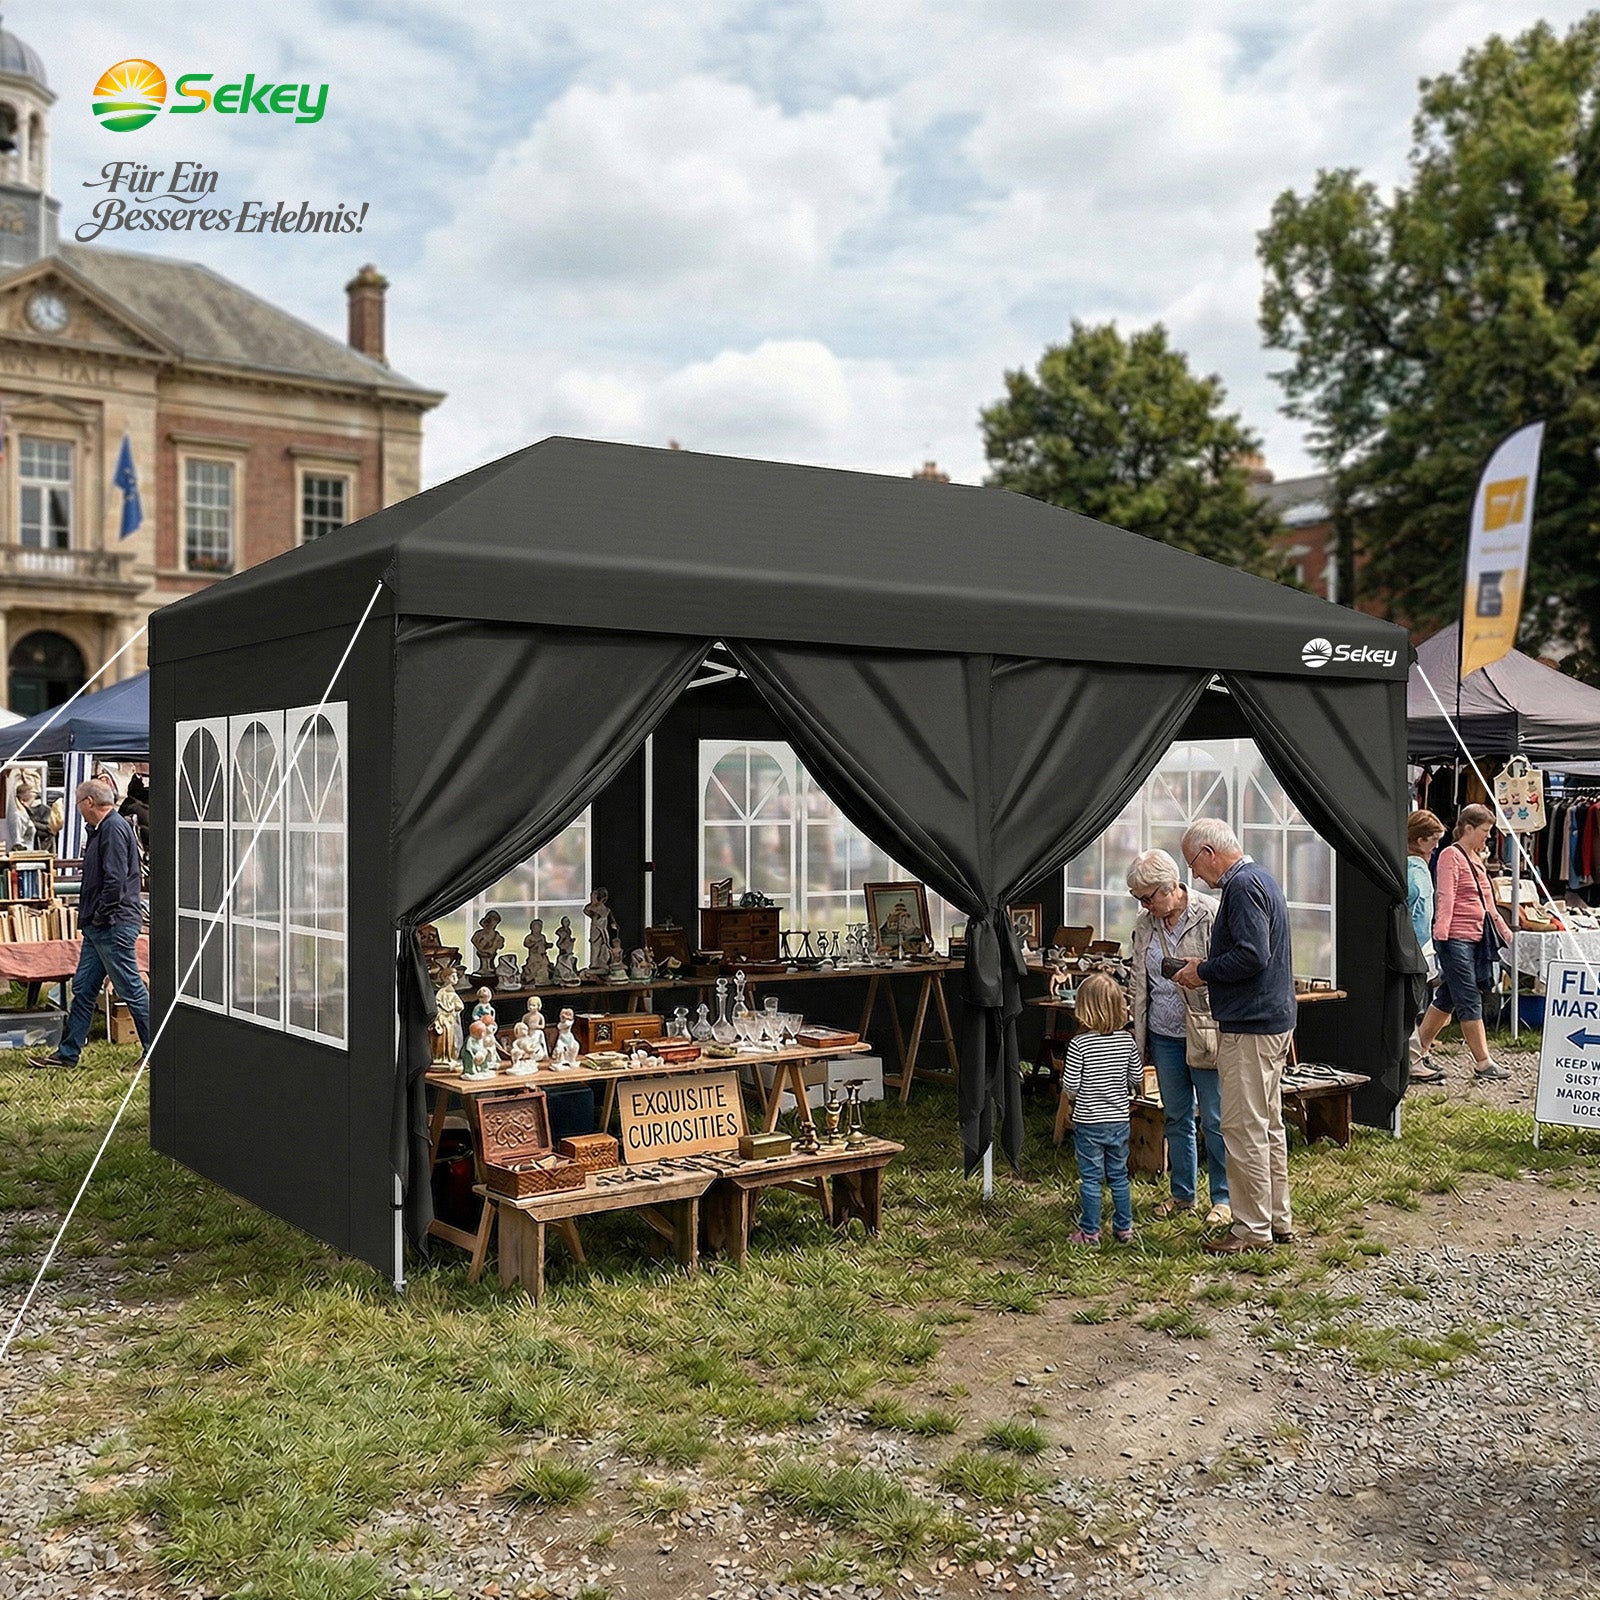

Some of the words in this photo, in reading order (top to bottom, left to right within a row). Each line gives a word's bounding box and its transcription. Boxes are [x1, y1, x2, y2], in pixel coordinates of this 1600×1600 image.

[1332, 644, 1397, 667] Sekey
[1561, 970, 1600, 996] FL
[1551, 999, 1600, 1020] MAR
[1555, 1057, 1588, 1070] KEEP
[632, 1085, 727, 1116] EXQUISITE
[629, 1113, 738, 1149] CURIOSITIES
